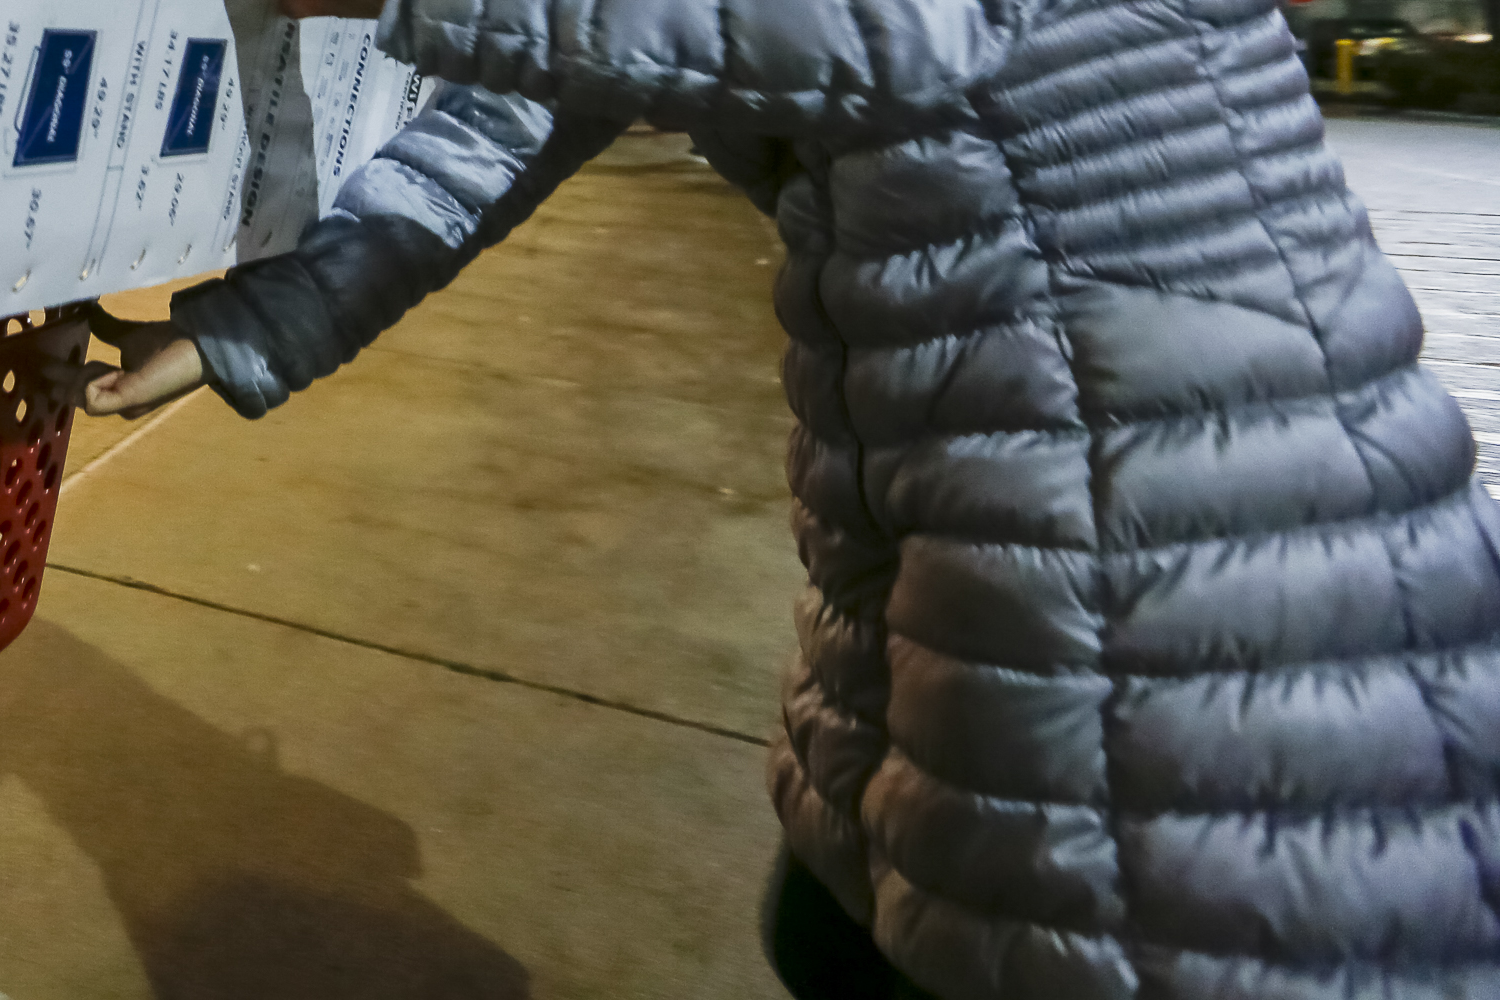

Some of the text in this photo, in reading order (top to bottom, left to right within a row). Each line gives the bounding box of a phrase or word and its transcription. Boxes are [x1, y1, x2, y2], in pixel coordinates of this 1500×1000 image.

[0, 20, 20, 79] 35.27
[45, 75, 68, 142] DIAGONAL
[114, 40, 146, 148] WITH STAND
[153, 81, 168, 110] LBS
[185, 76, 205, 135] DIAGONAL
[332, 33, 371, 176] CONNECTIONS
[240, 133, 271, 226] DESIGN
